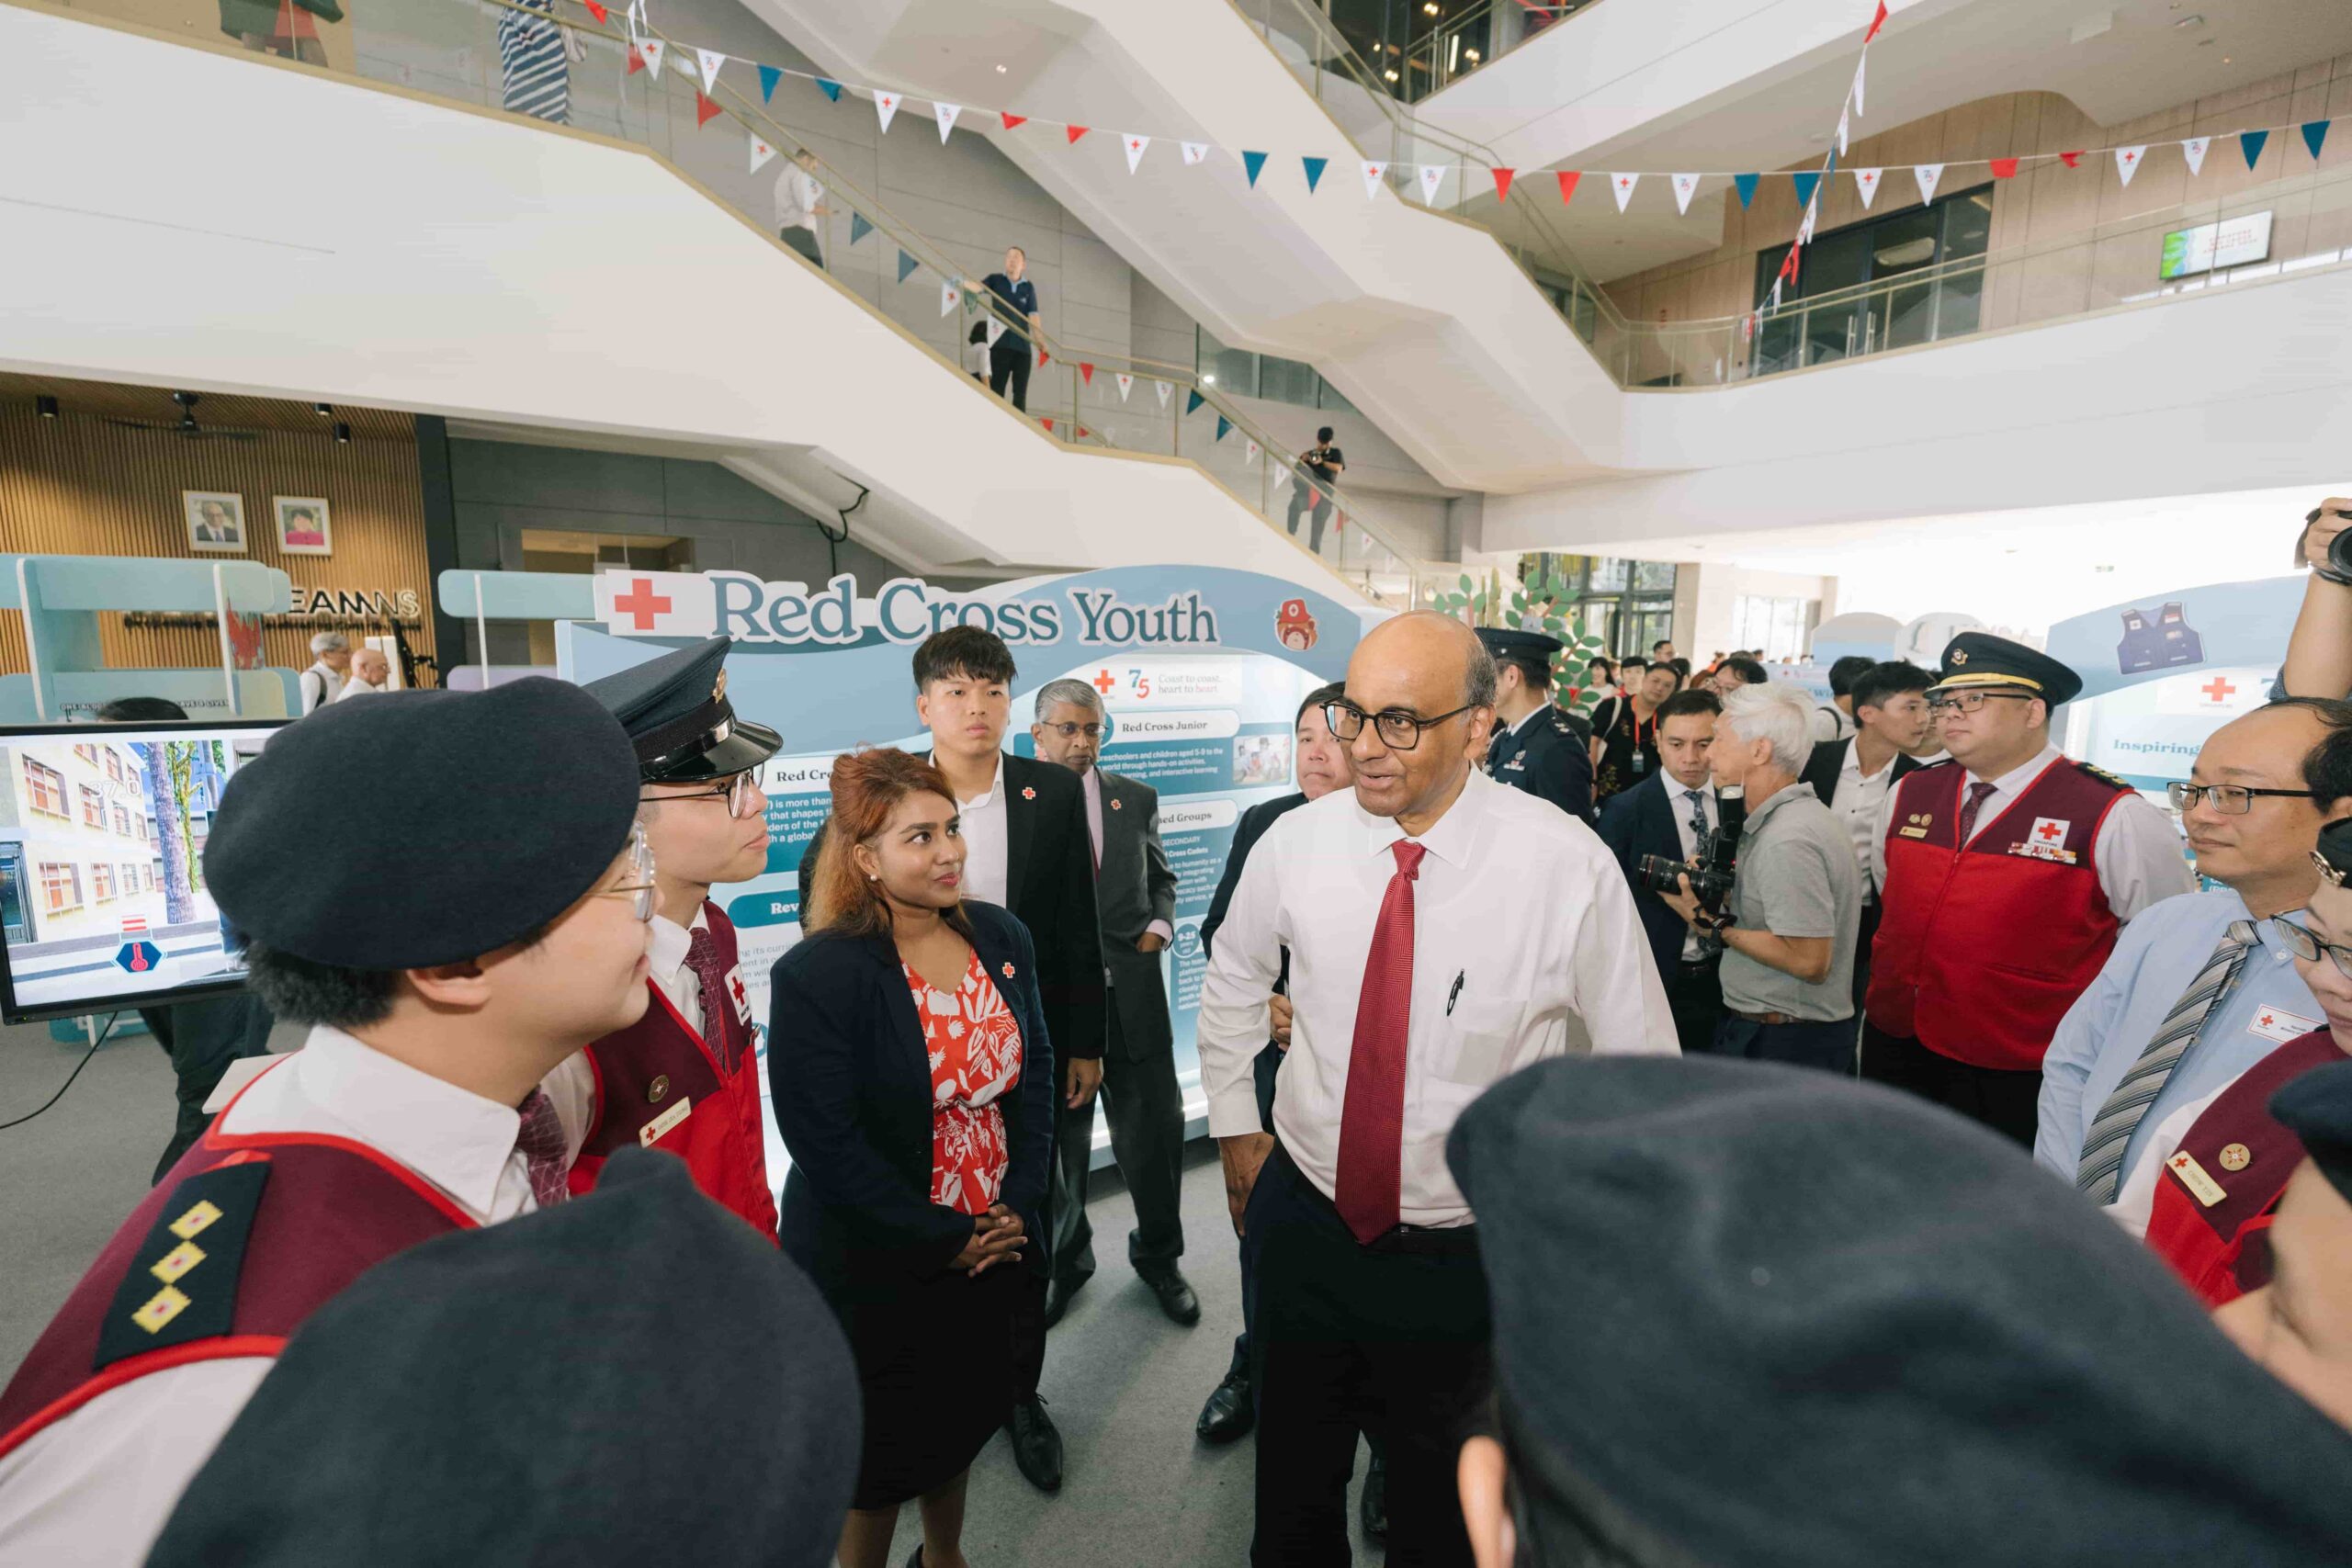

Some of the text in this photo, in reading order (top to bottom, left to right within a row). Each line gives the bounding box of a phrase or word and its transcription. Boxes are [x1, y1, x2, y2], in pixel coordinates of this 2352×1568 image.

[709, 577, 1217, 642] Red Cross Youth
[1128, 670, 1149, 699] 75
[1159, 683, 1182, 694] heart
[1184, 684, 1193, 693] to
[1123, 720, 1208, 732] Red Cross Junior
[2113, 739, 2199, 756] Inspiring
[777, 770, 805, 782] Red
[775, 799, 784, 808] is
[786, 799, 809, 808] more
[811, 797, 831, 806] than
[770, 810, 789, 820] that
[791, 808, 824, 820] shapes
[1177, 811, 1212, 823] Groups
[767, 823, 789, 832] ders
[791, 820, 801, 829] of
[803, 819, 819, 829] the
[779, 834, 786, 842] a
[770, 902, 799, 915] Rev
[766, 943, 791, 953] curri
